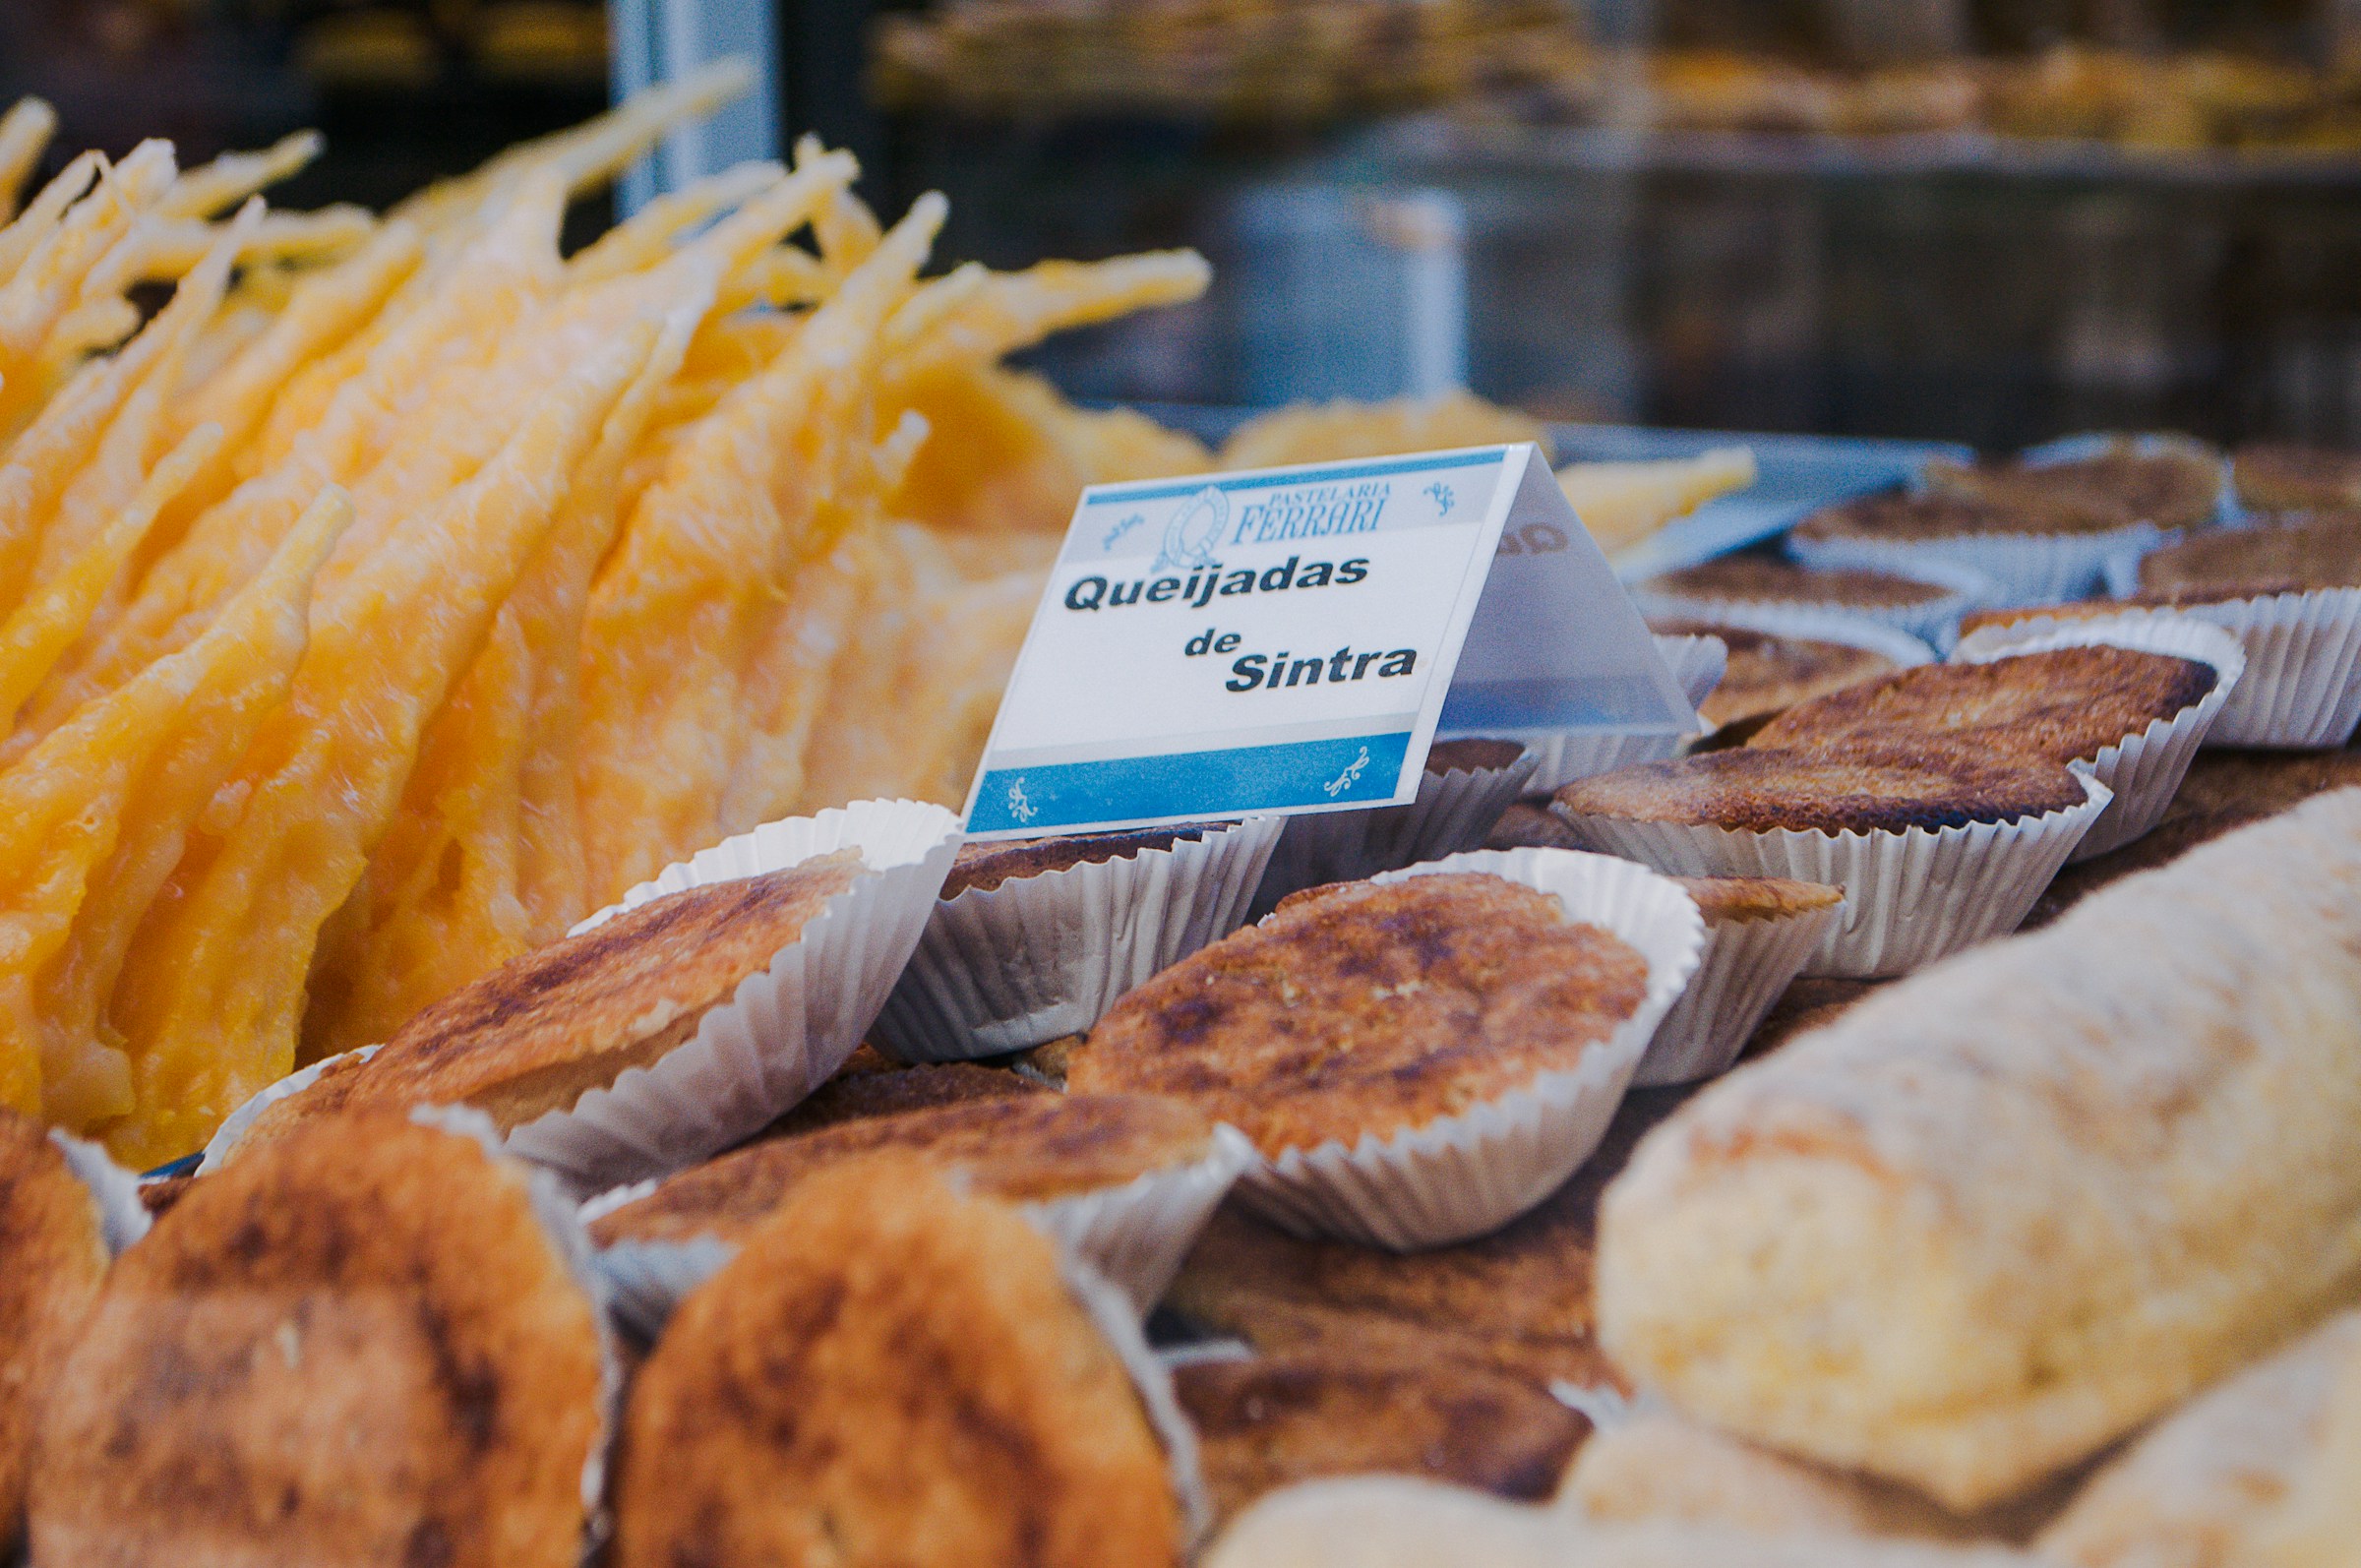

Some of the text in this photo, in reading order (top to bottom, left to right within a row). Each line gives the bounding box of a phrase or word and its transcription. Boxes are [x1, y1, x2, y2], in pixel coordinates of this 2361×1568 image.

[1270, 483, 1390, 507] PASTELARIA
[1231, 499, 1385, 545] FERRARI
[1064, 556, 1369, 611] Queijadas
[1184, 629, 1241, 656] de
[1226, 645, 1418, 693] Sintra
